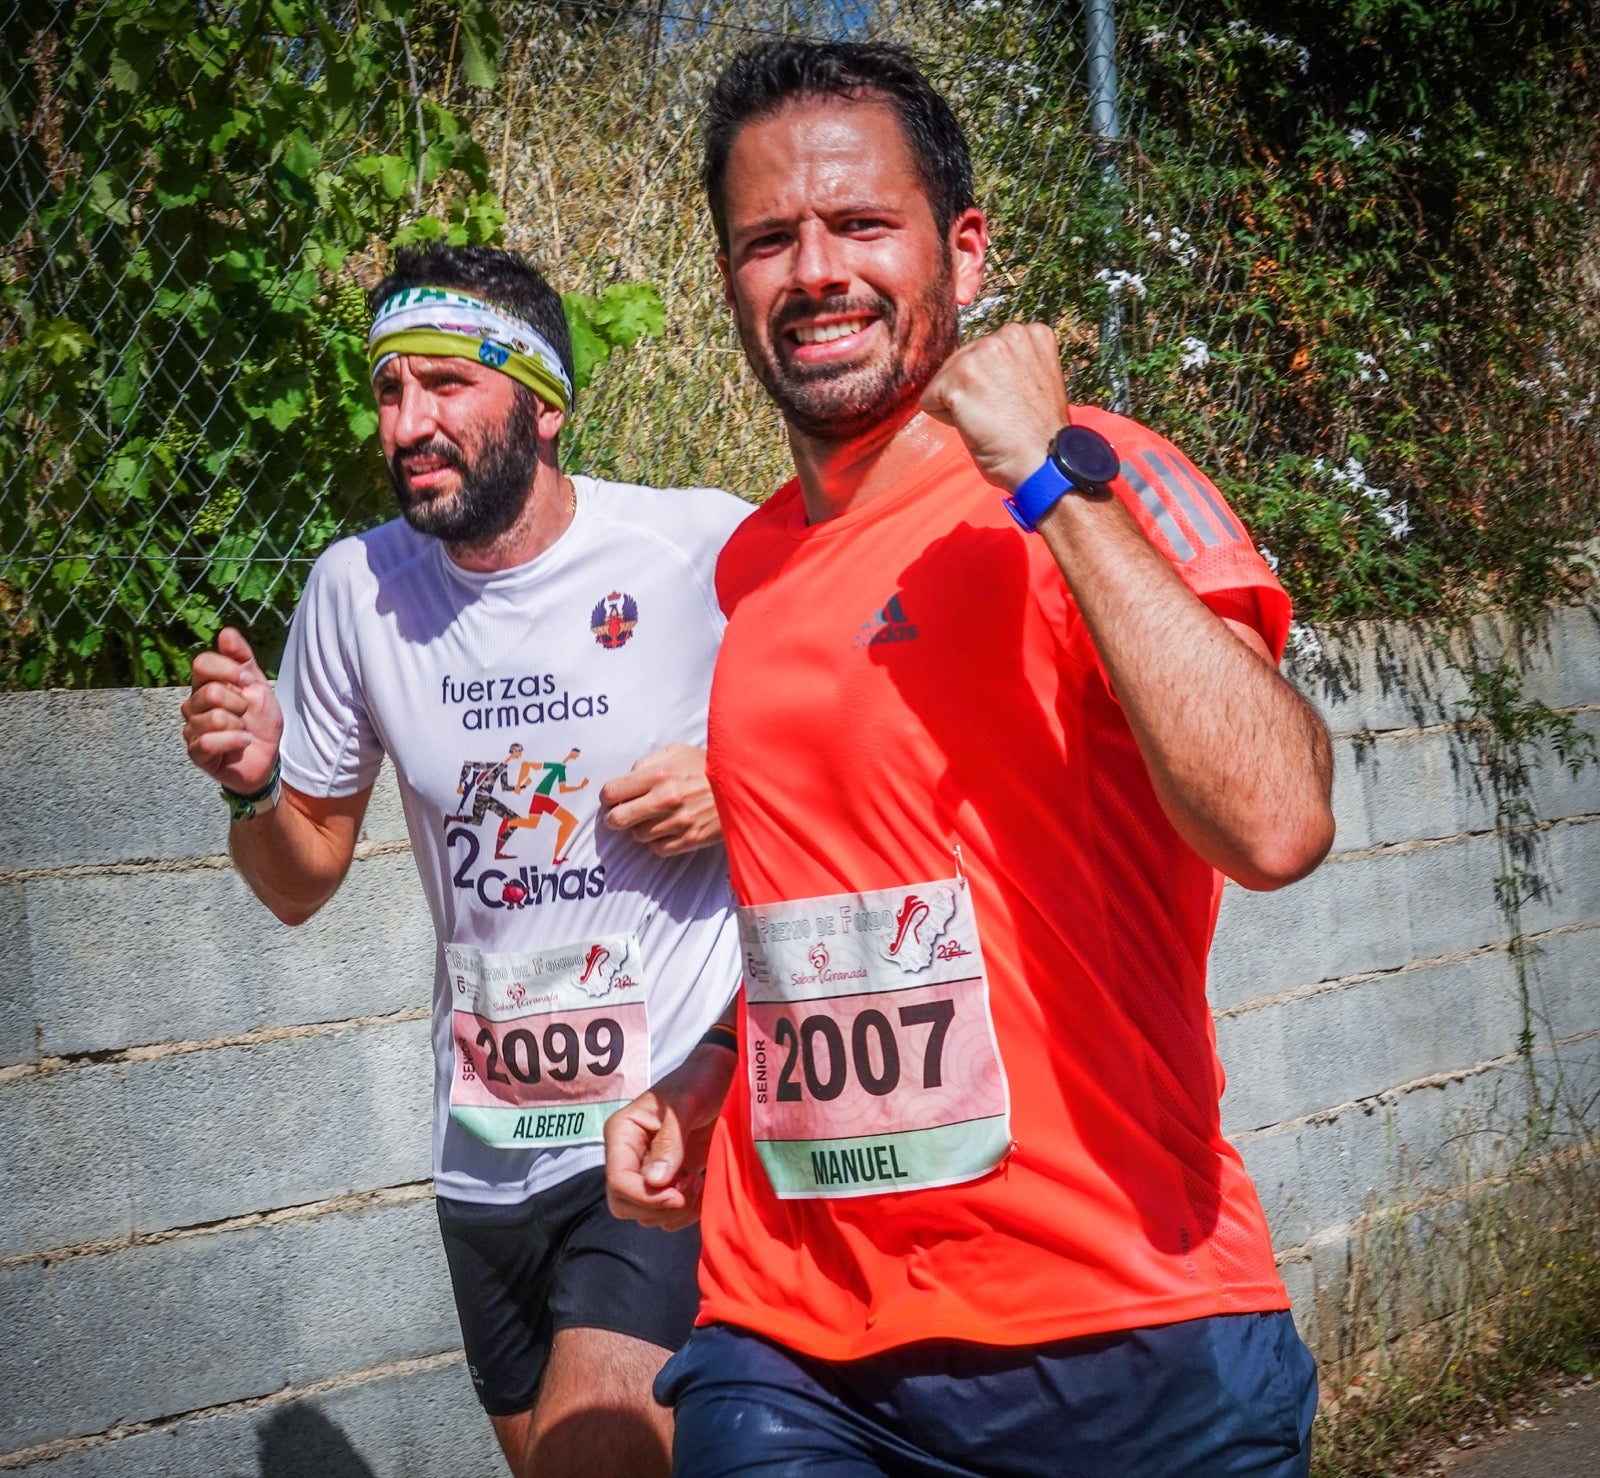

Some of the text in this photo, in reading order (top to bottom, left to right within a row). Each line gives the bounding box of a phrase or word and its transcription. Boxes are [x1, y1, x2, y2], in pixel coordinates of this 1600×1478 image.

[850, 624, 918, 650] idas
[441, 673, 556, 704] fuerzas
[462, 691, 609, 730] armadas
[446, 827, 605, 909] 2 Clinas
[790, 966, 868, 986] Sabor Granada
[476, 1018, 625, 1086] 2099
[775, 999, 955, 1102] 2007
[756, 1039, 768, 1104] SENIOR
[513, 1112, 585, 1139] ALBERTO
[811, 1145, 908, 1185] MANUEL
